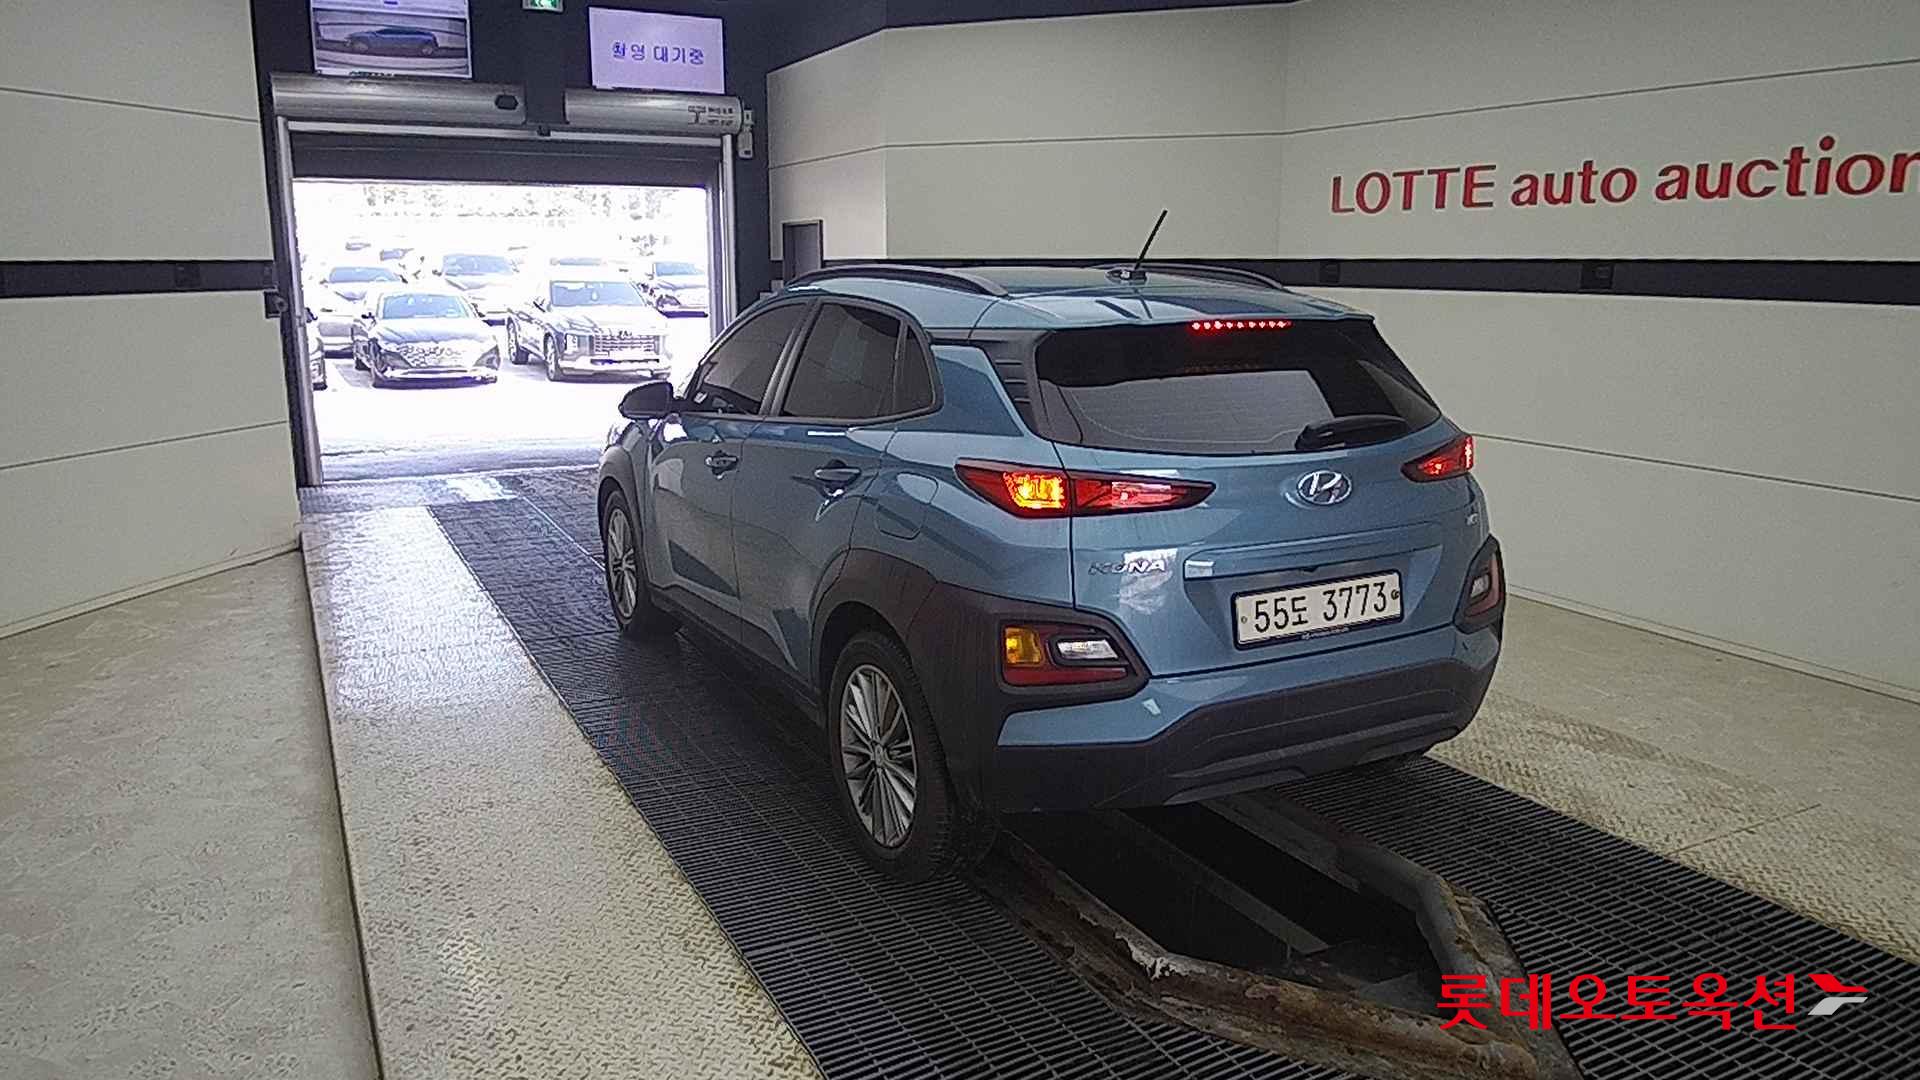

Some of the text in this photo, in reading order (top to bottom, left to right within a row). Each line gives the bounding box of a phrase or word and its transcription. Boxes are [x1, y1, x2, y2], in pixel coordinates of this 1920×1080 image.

[653, 45, 705, 66] 대기중
[1331, 164, 1497, 215] LOTTE
[1511, 159, 1638, 207] auto
[1088, 558, 1167, 576] KONA
[1253, 581, 1387, 633] 55도 3773
